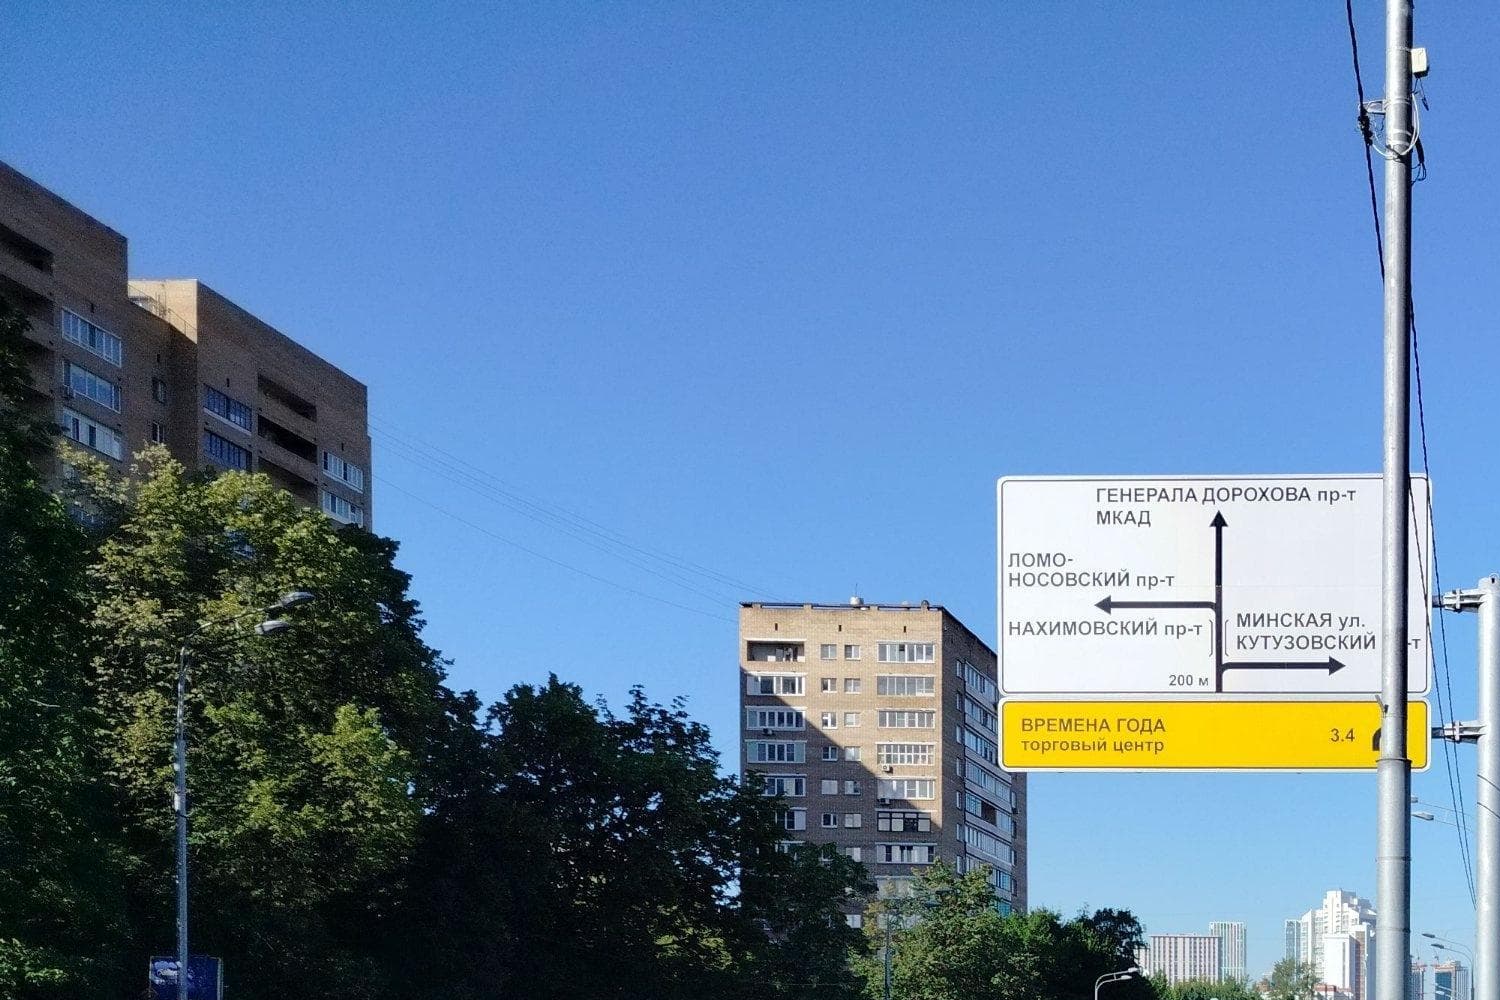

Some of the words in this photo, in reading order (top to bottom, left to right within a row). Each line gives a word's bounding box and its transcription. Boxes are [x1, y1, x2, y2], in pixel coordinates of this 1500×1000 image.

[1096, 488, 1197, 503] ГЕНЕРАЛА
[1202, 487, 1311, 505] ДОРОХОВА
[1318, 490, 1356, 505] пр-т
[1096, 511, 1151, 527] МКАД
[1008, 553, 1073, 568] ЛОМО-
[1008, 569, 1130, 587] НОСОВСКИЙ
[1137, 575, 1175, 590] пр-т
[1008, 617, 1158, 636] НАХИМОВСКИЙ
[1165, 624, 1203, 640] пр-т
[1236, 613, 1332, 628] МИНСКАЯ
[1338, 616, 1366, 632] ул.
[1236, 632, 1376, 650] КУТУЗОВСКИЙ
[1169, 675, 1193, 687] 200
[1198, 677, 1209, 687] м
[1021, 718, 1111, 733] ВРЕМЕНА
[1116, 718, 1166, 735] ГОДА
[1330, 728, 1355, 743] 3.4
[1021, 737, 1107, 755] торговый
[1113, 740, 1164, 755] центр
